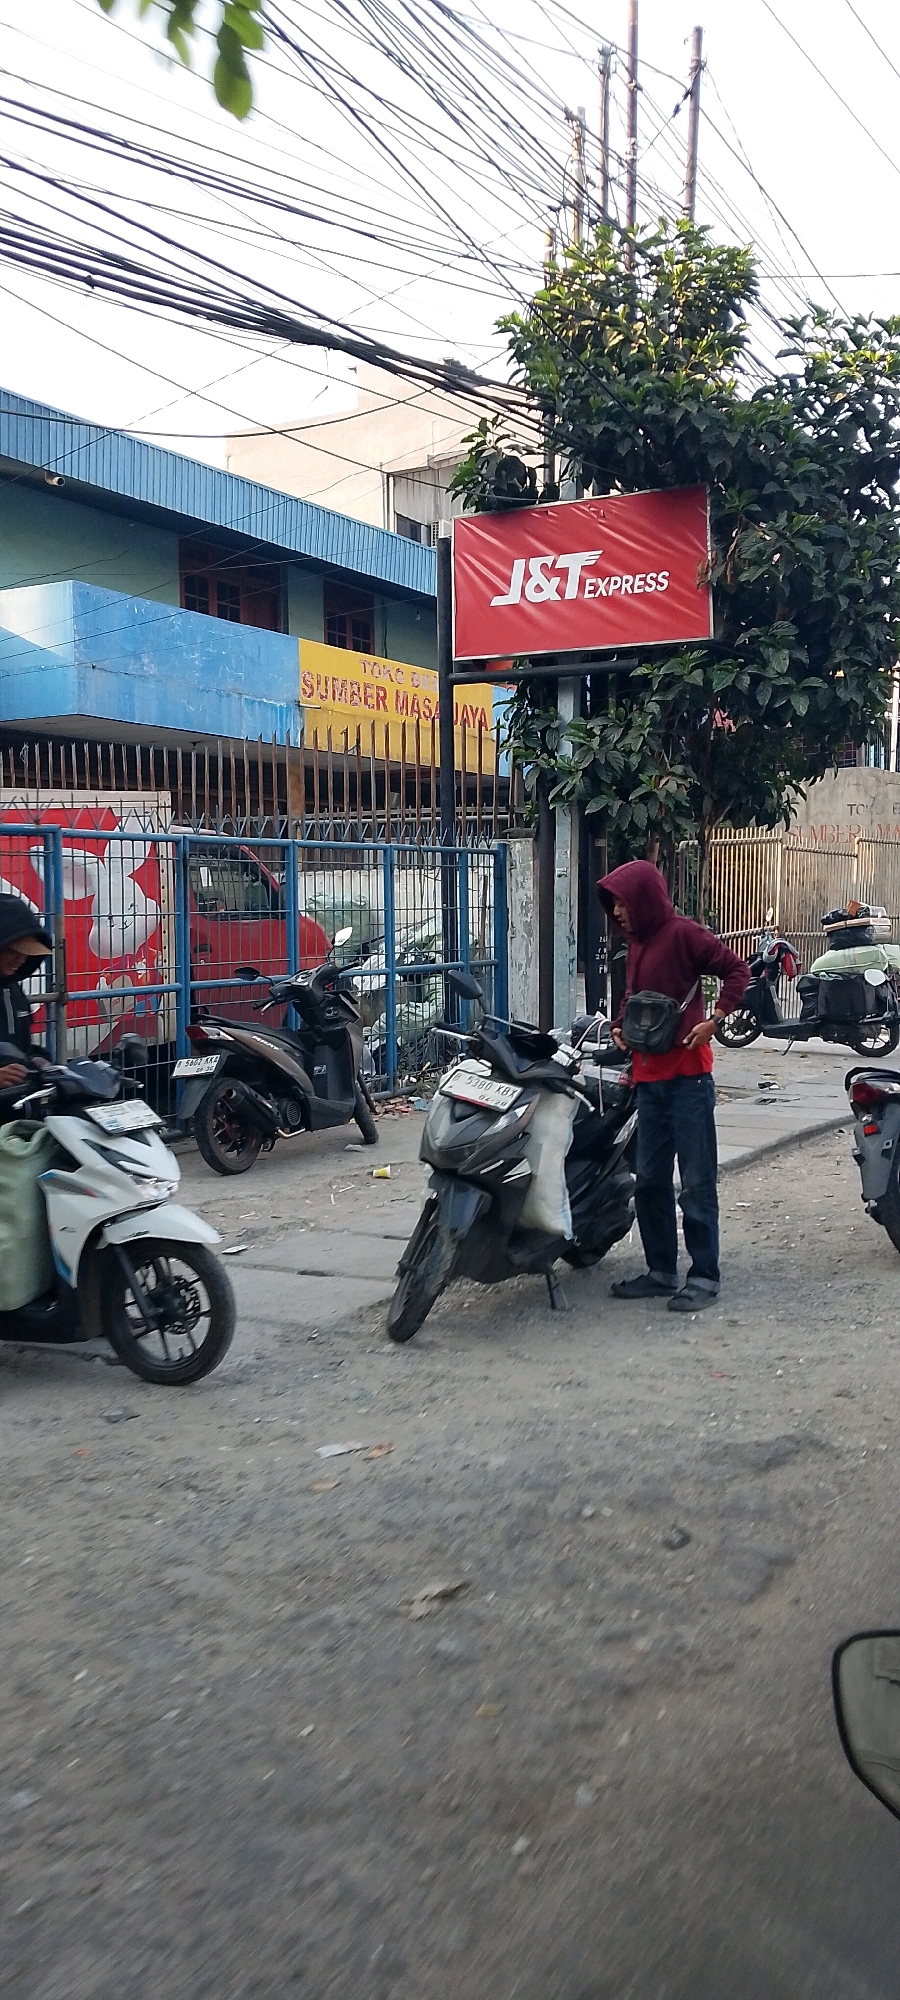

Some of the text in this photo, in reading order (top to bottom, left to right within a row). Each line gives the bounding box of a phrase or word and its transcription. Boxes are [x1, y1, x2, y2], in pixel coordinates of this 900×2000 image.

[490, 550, 670, 607] J&T EXPRESS
[359, 659, 405, 685] TOKO
[301, 670, 389, 713] SUMBER
[466, 1075, 493, 1091] 5380
[495, 1084, 518, 1098] KBX
